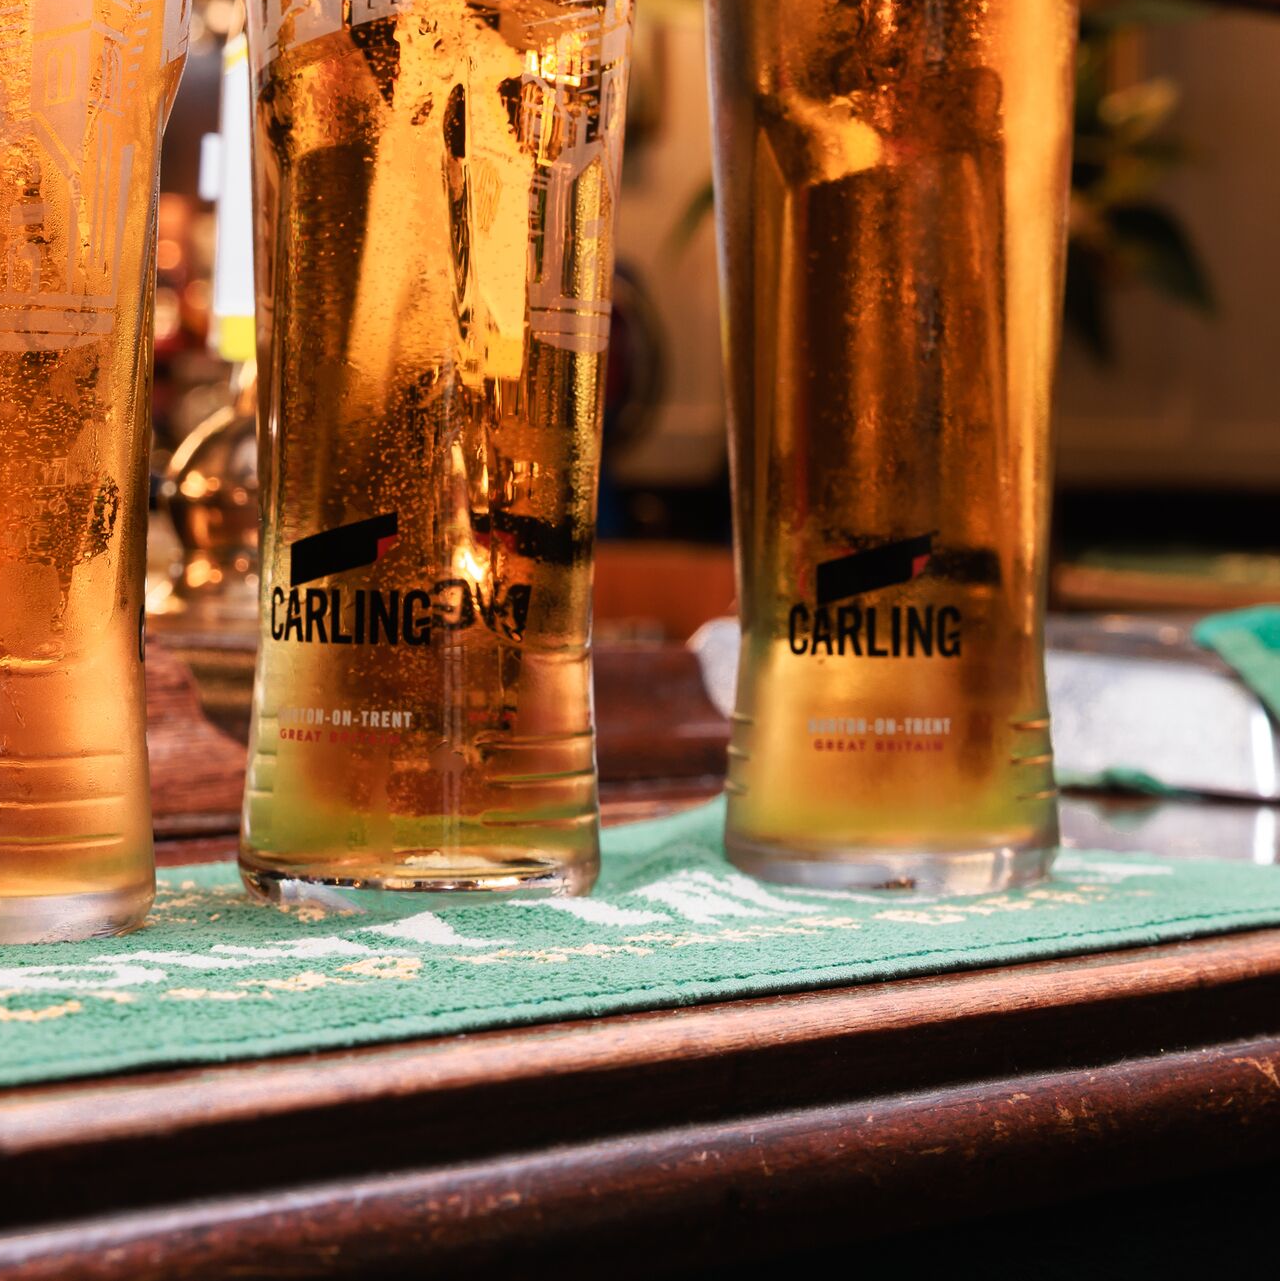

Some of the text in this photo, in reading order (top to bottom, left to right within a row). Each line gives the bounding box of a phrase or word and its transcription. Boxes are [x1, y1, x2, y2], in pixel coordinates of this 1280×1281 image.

[270, 585, 431, 646] CARLING
[788, 604, 962, 657] CARLING
[277, 707, 413, 728] TON-ON-TRENT
[279, 728, 322, 743] GREAT
[813, 738, 945, 753] GREAT BRITAIN
